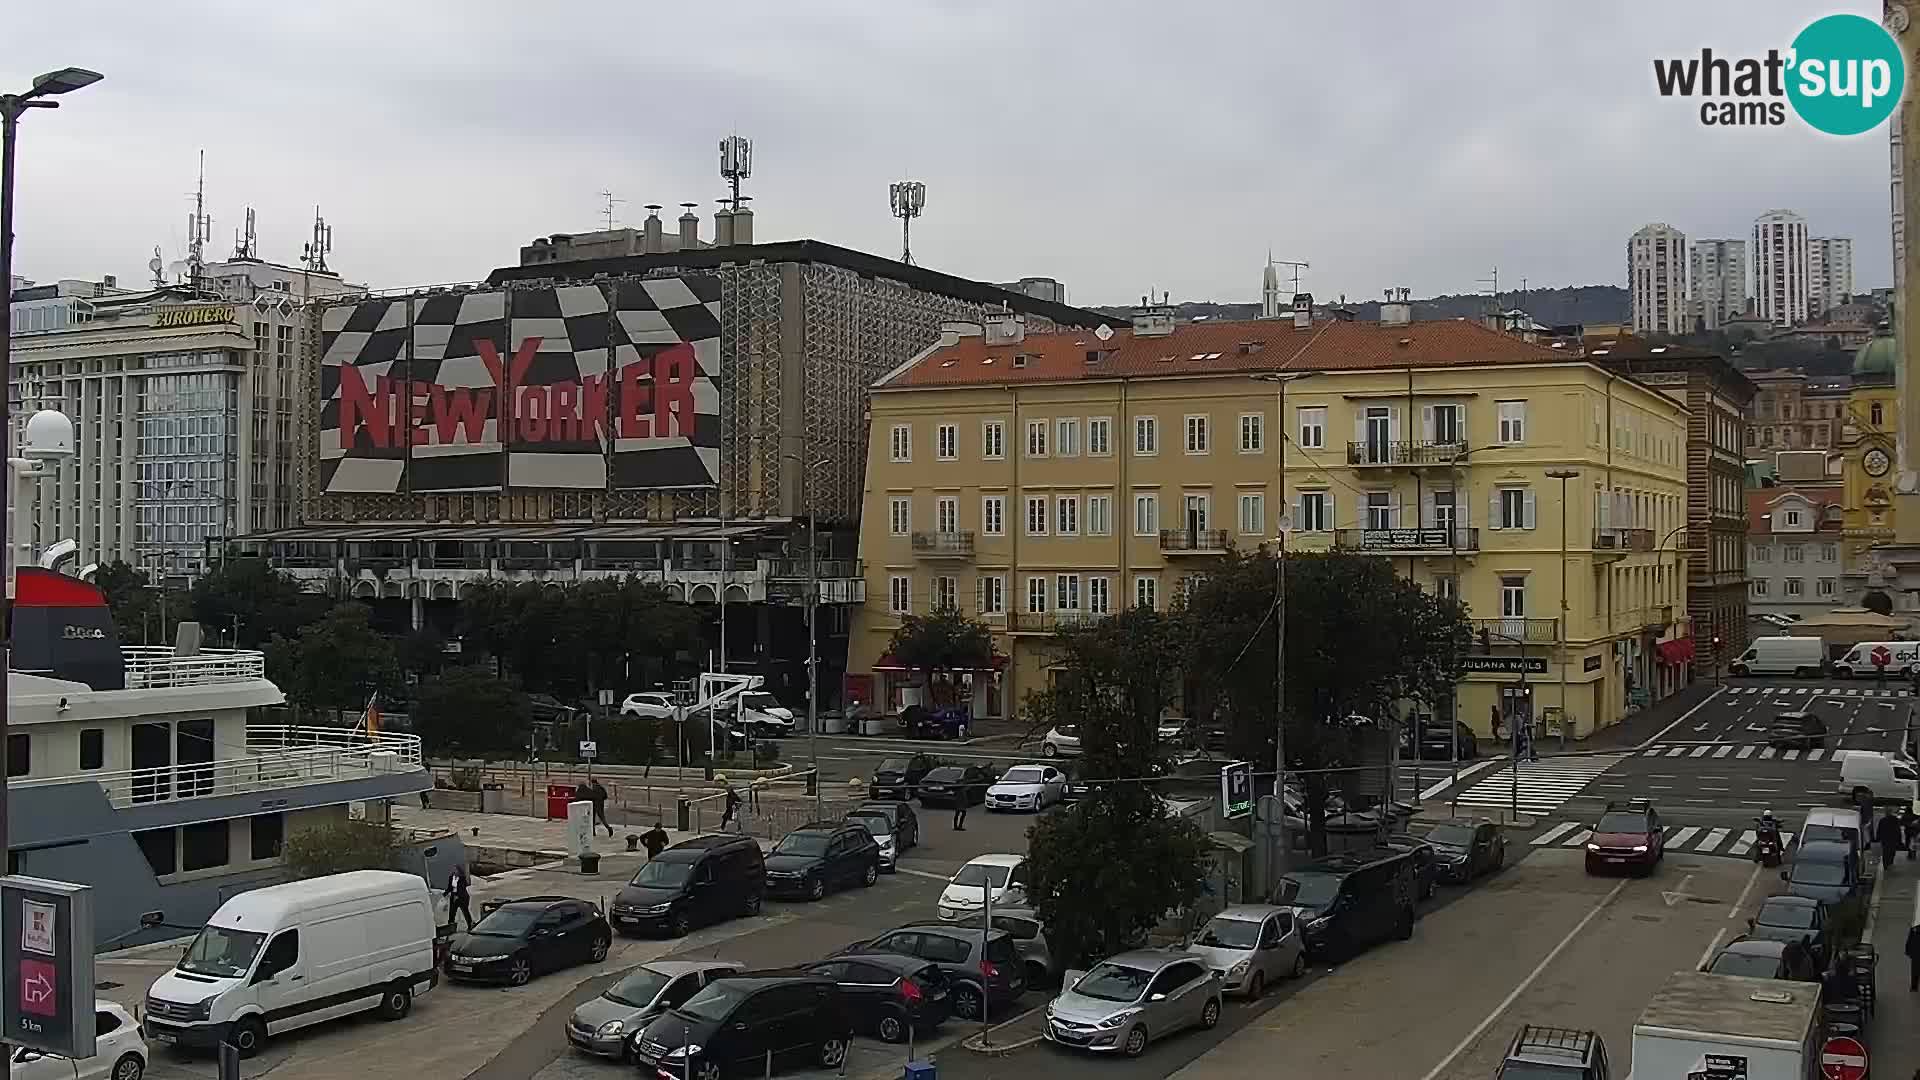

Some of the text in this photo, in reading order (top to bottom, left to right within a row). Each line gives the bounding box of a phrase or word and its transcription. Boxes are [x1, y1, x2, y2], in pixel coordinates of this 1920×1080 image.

[1461, 660, 1541, 670] JULIANA NAILS
[22, 1018, 42, 1033] 5 km
